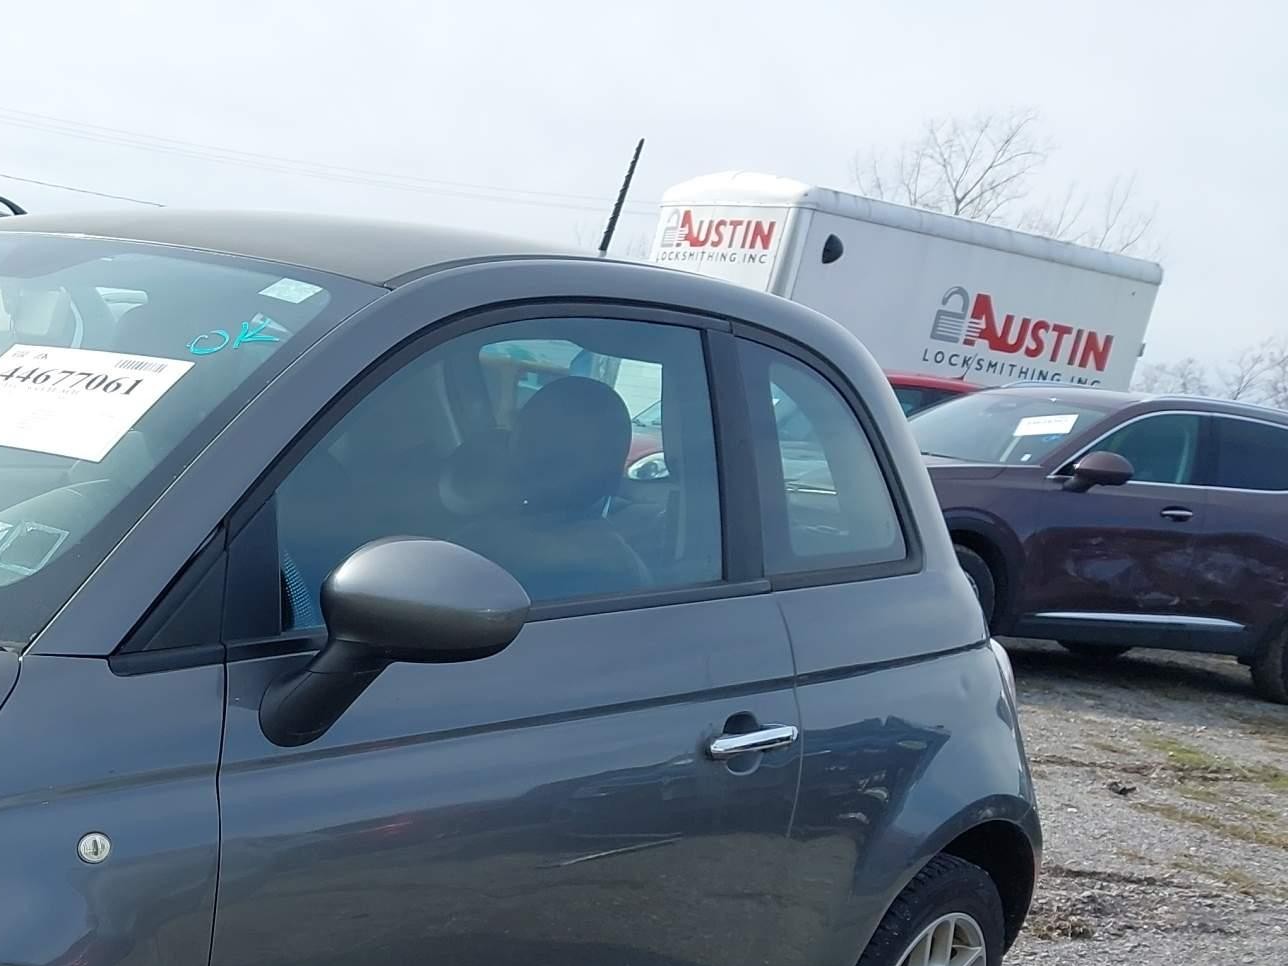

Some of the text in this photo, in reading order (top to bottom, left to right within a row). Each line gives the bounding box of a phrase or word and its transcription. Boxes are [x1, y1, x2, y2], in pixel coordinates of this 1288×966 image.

[675, 209, 776, 250] AUSTIN
[656, 251, 768, 264] LOCKSMITHING INC
[187, 317, 280, 355] OK
[963, 293, 1114, 372] AUSTIN
[0, 366, 144, 396] 44677061
[922, 348, 1062, 382] LOCKSMITHING
